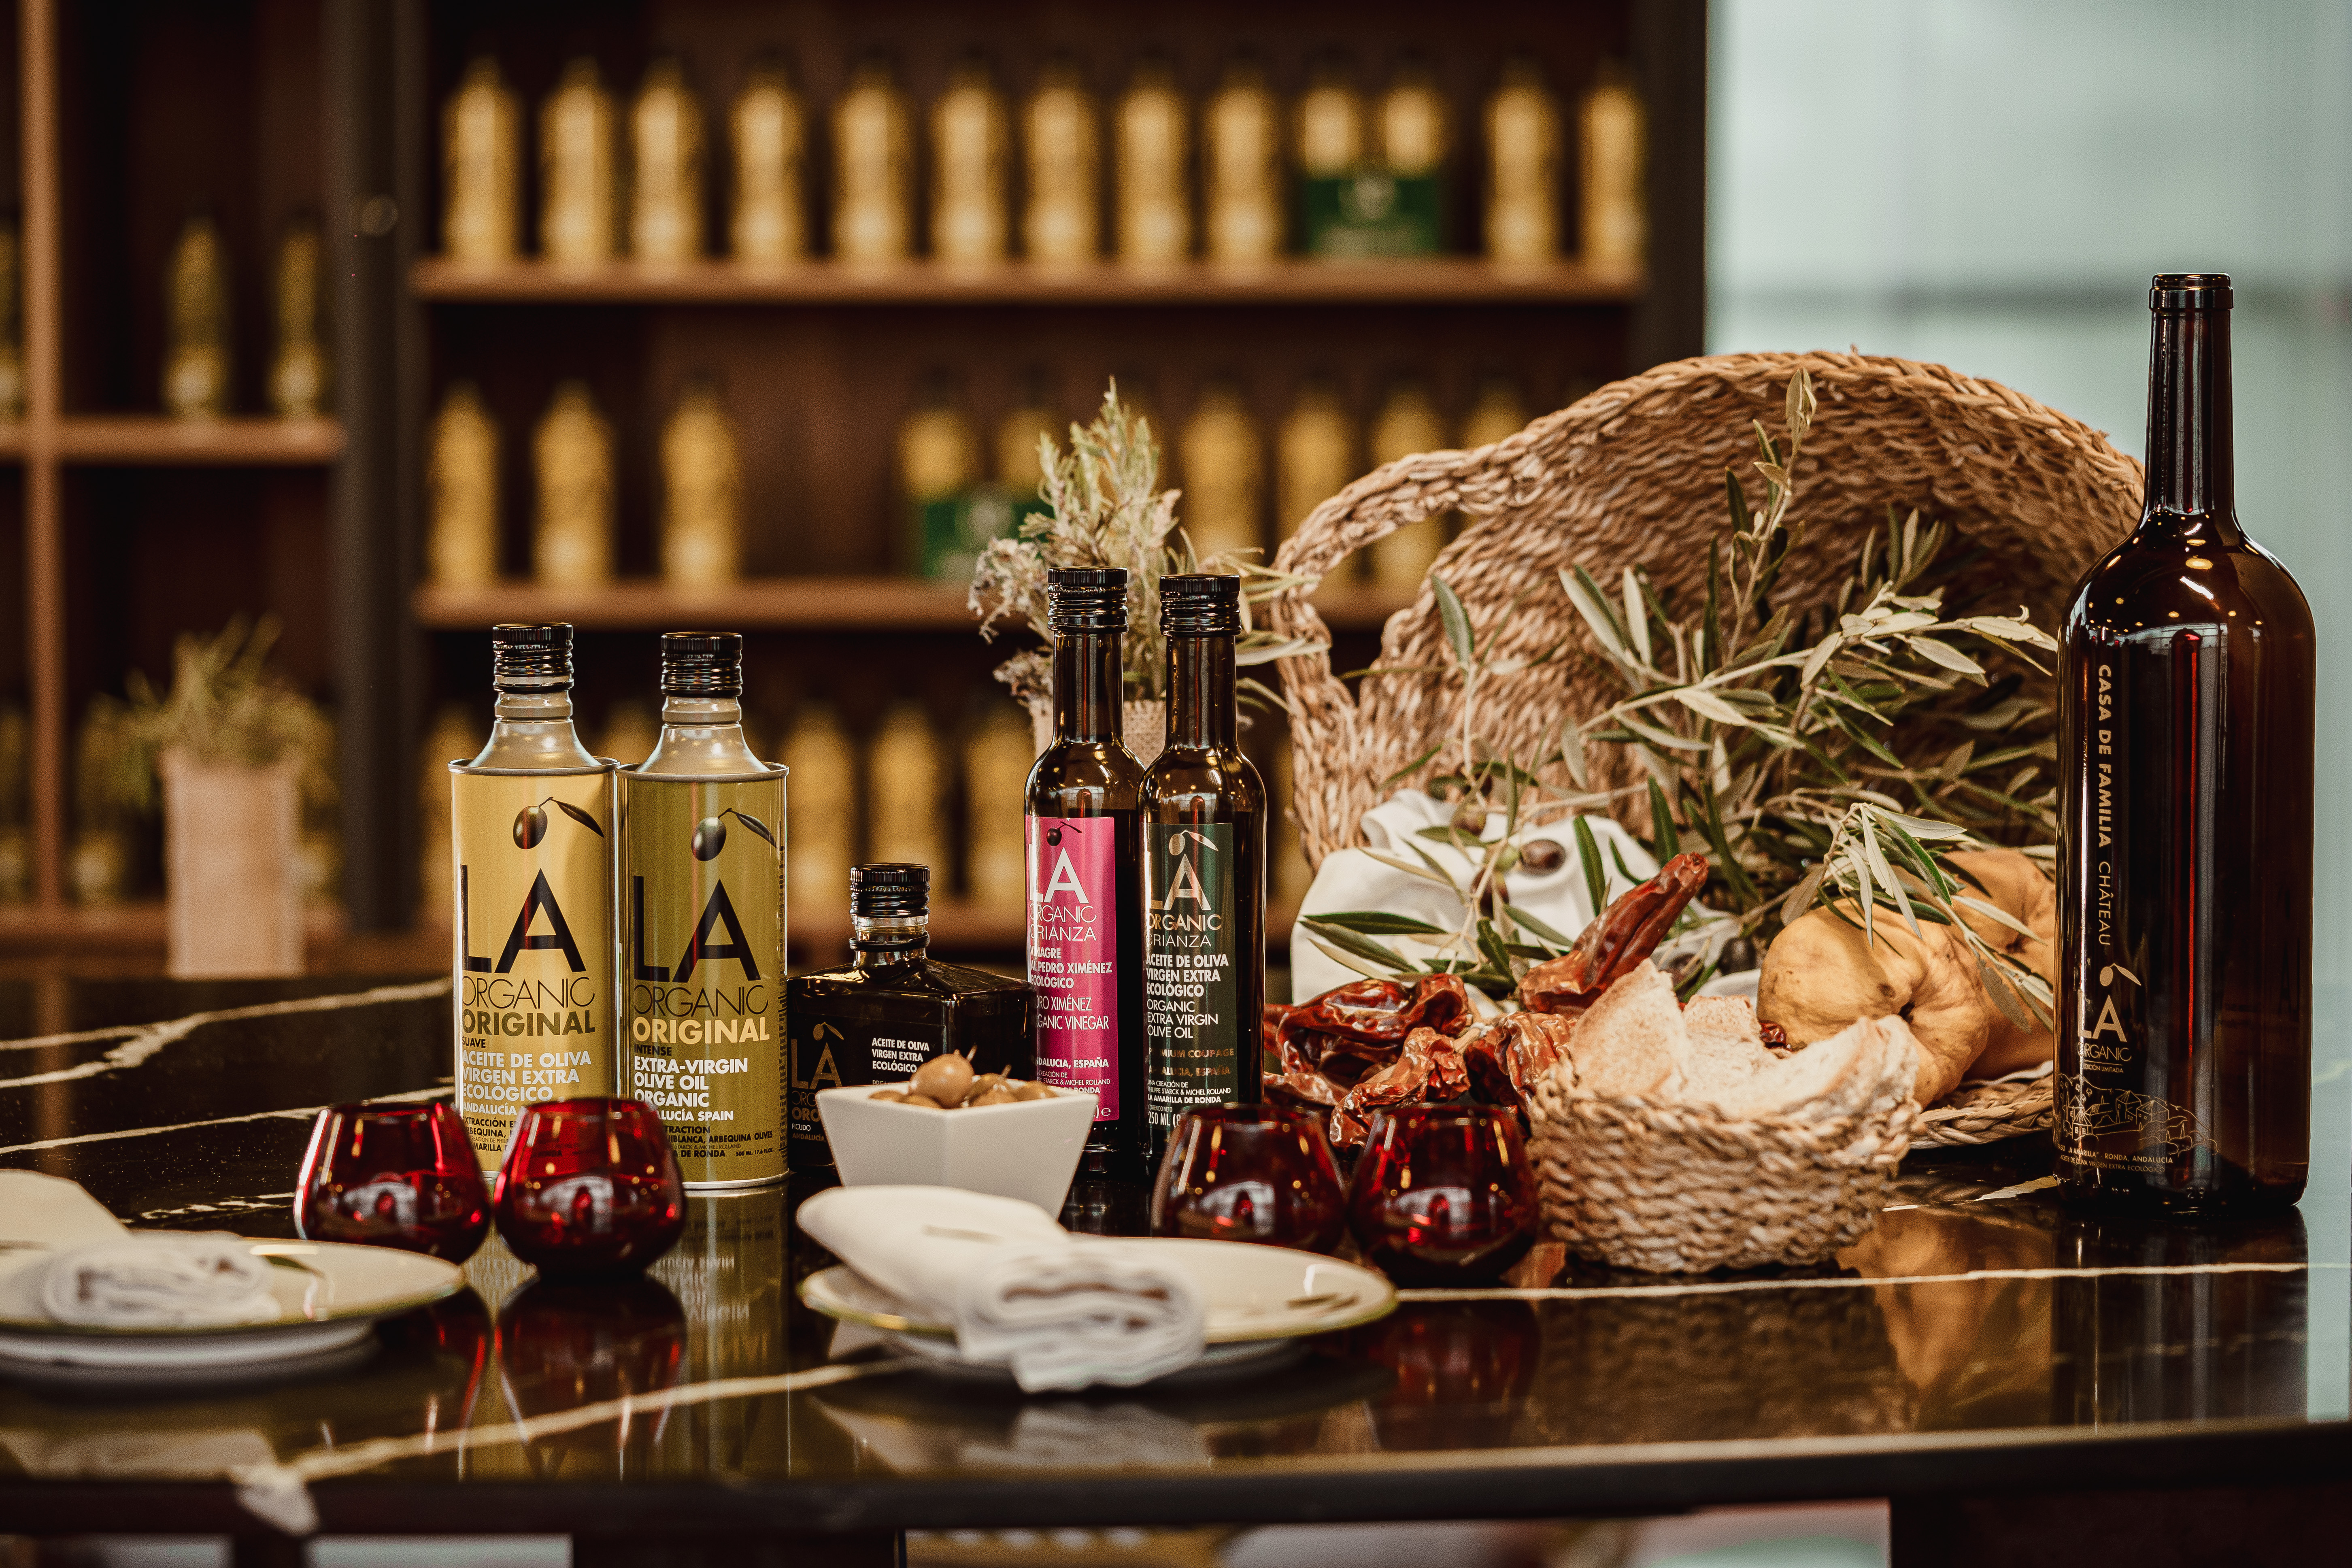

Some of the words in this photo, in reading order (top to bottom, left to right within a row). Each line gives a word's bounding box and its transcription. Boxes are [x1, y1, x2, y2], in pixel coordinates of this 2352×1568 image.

[2099, 665, 2111, 721] CASA
[2099, 730, 2111, 755] DE
[2099, 764, 2111, 848] FAMILIA
[1029, 844, 1089, 903] LA
[2099, 862, 2114, 945] CHÂTEAU
[460, 865, 586, 973] LA
[1030, 904, 1097, 923] ORGANIC
[1147, 911, 1221, 931] ORGANIC
[634, 875, 761, 983] LA
[1030, 924, 1096, 941] CRIANZA
[1147, 934, 1211, 947] CRIANZA
[1030, 945, 1061, 959] VINAGRE
[1146, 953, 1173, 967] ACEITE
[1176, 955, 1190, 967] DE
[1194, 954, 1229, 967] OLIVA
[1031, 960, 1037, 971] AL
[1038, 962, 1064, 973] PEDRO
[1067, 960, 1112, 974] XIMÉNEZ
[1031, 974, 1074, 988] ECOLÓGICO
[1146, 969, 1179, 981] VIRGEN
[1184, 970, 1221, 982] EXTRA
[462, 976, 595, 1008] ORGANIC
[1147, 981, 1204, 997] ECOLÓGICO
[634, 985, 768, 1017] ORGANIC
[1051, 994, 1092, 1011] XIMÉNEZ
[1147, 999, 1195, 1012] ORGANIC
[462, 1009, 595, 1036] ORIGINAL
[1065, 1015, 1109, 1030] VINEGAR
[1148, 1013, 1174, 1024] EXTRA
[1176, 1014, 1218, 1025] VIRGIN
[633, 1017, 770, 1045] ORIGINAL
[1147, 1025, 1171, 1038] OLIVE
[1174, 1027, 1193, 1038] OIL
[462, 1036, 486, 1048] SUAVE
[634, 1044, 672, 1056] INTENSE
[872, 1038, 895, 1048] ACEITE
[897, 1040, 906, 1049] DE
[908, 1041, 929, 1051] OLIVA
[463, 1050, 504, 1067] ACEITE
[511, 1053, 532, 1068] DE
[540, 1051, 591, 1068] OLIVA
[872, 1049, 897, 1059] VIRGEN
[900, 1051, 923, 1062] EXTRA
[1188, 1049, 1234, 1057] COUPAGE
[634, 1056, 748, 1074] EXTRA-VIRGIN
[791, 1039, 842, 1089] LA
[872, 1060, 917, 1073] ECOLÓGICO
[1074, 1057, 1109, 1068] ESPAÑA
[463, 1066, 515, 1084] VIRGEN
[523, 1069, 580, 1085] EXTRA
[634, 1072, 674, 1089] OLIVE
[680, 1075, 709, 1090] OIL
[463, 1082, 553, 1102] ECOLÓGICO
[635, 1089, 709, 1107] ORGANIC
[464, 1102, 517, 1115] ANDALUCÍA
[698, 1111, 734, 1121] SPAIN
[1148, 1111, 1158, 1125] 250
[1160, 1113, 1170, 1126] ML
[708, 1134, 751, 1142] ARBEQUINA
[754, 1131, 773, 1140] OLIVES
[2105, 1153, 2129, 1162] RONDA,
